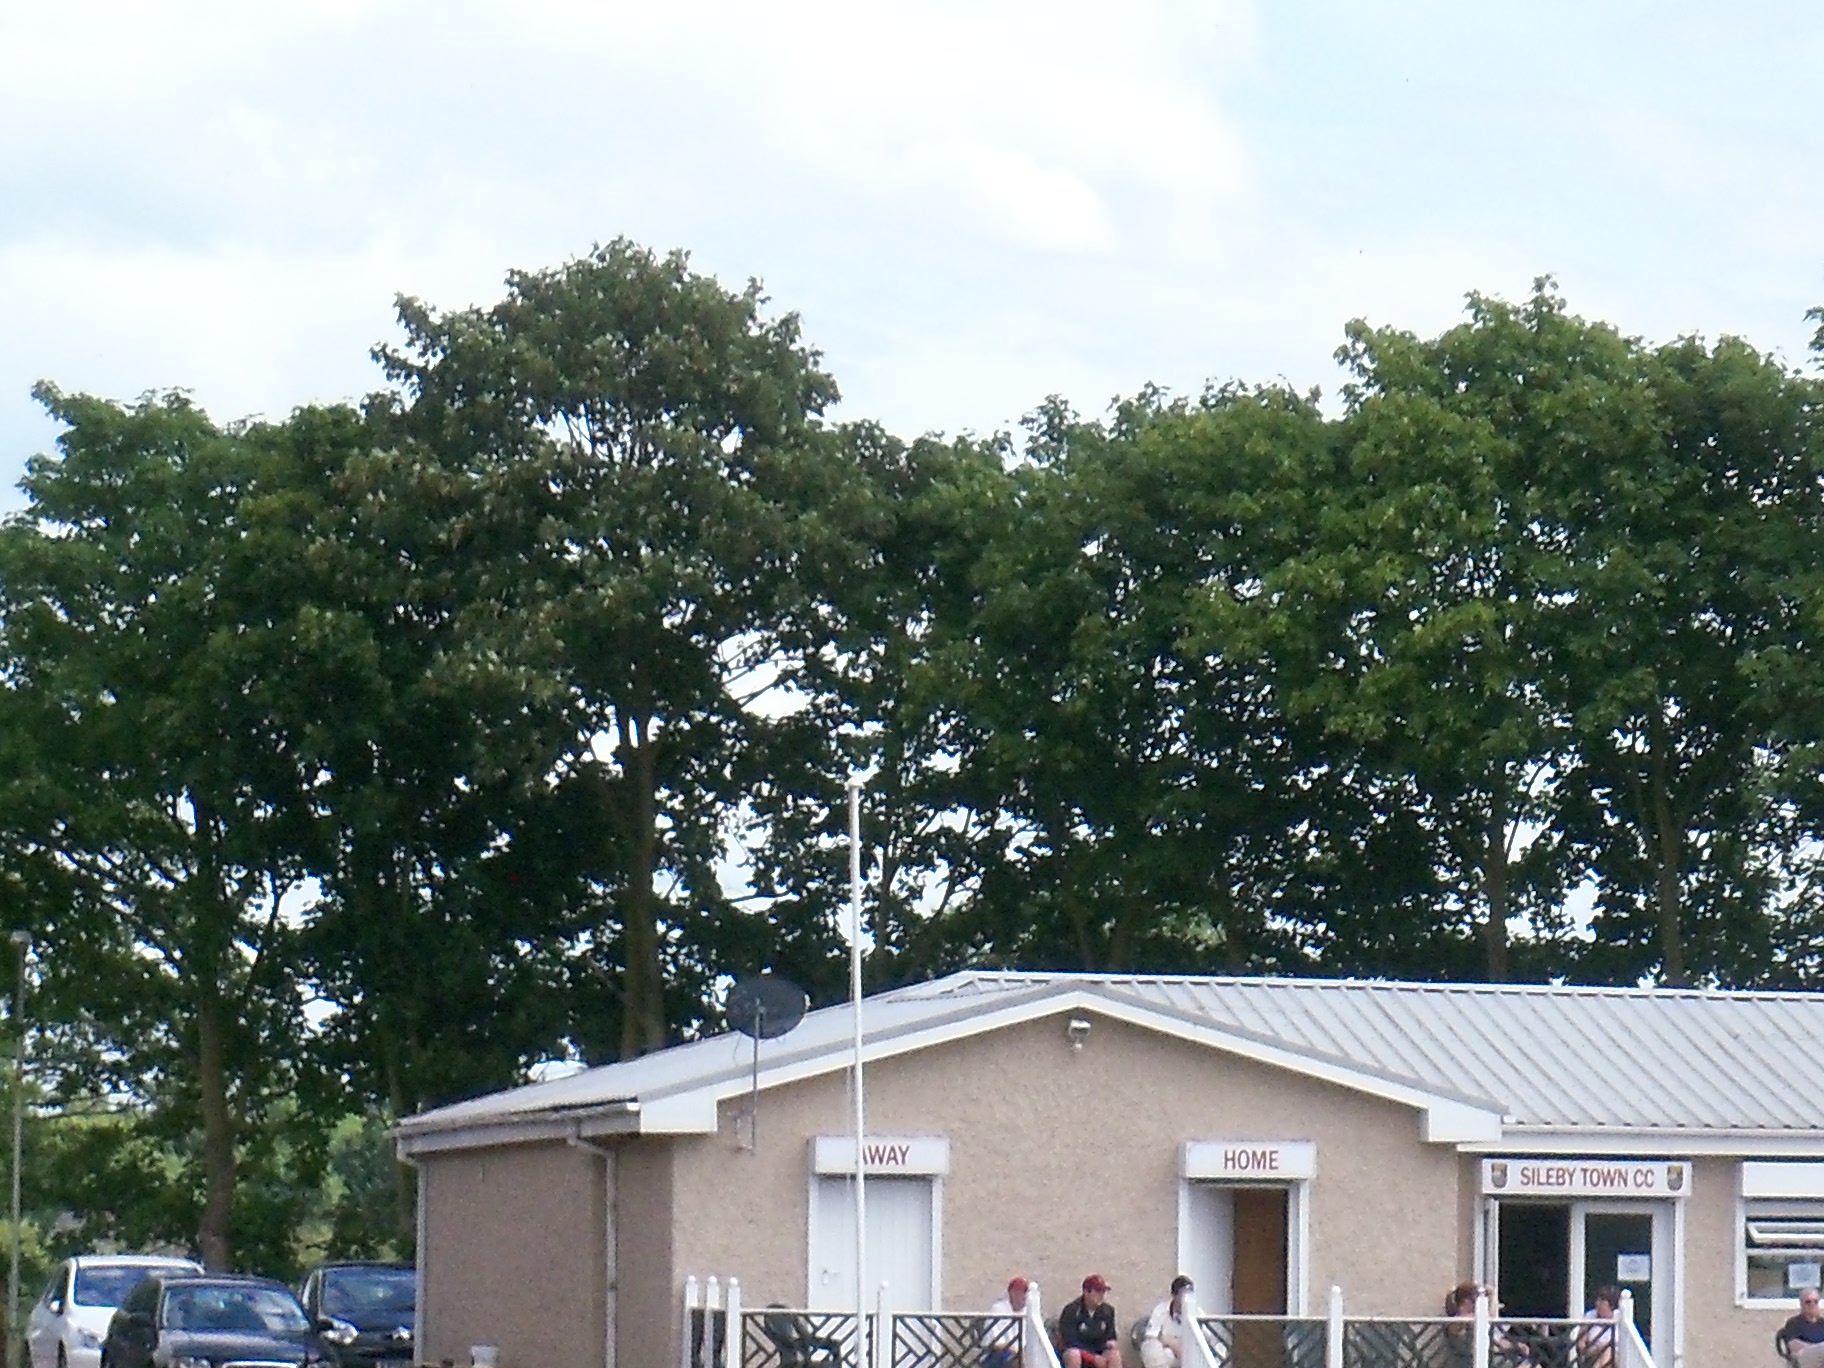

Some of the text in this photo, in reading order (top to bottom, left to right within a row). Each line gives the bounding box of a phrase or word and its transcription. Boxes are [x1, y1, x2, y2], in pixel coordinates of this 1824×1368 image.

[1223, 1150, 1279, 1170] HOME
[1520, 1167, 1655, 1188] SILEBY TOWN CC
